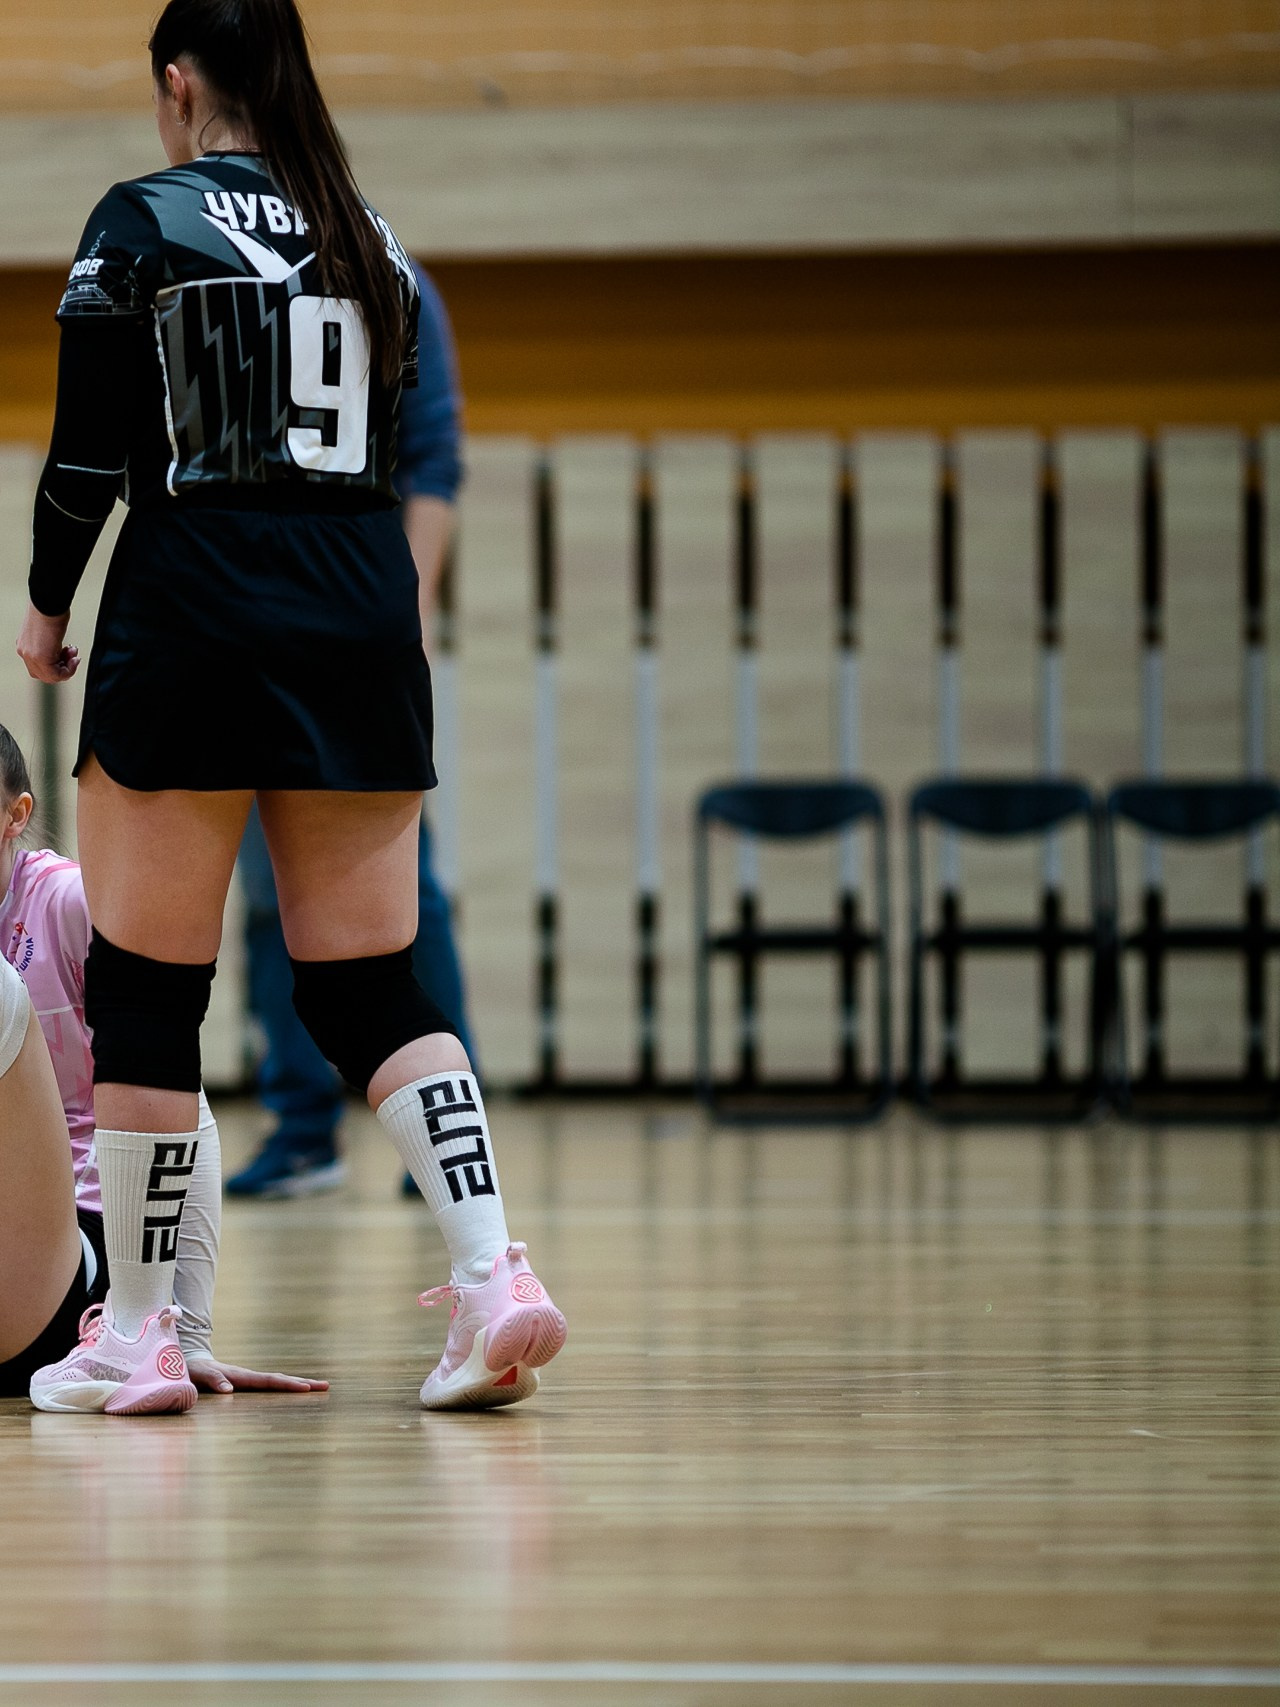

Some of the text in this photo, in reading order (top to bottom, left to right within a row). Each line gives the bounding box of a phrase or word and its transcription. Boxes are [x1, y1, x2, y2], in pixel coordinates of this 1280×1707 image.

[287, 295, 371, 474] 9
[18, 937, 35, 972] ШКОЛА
[416, 1079, 497, 1203] ELITE
